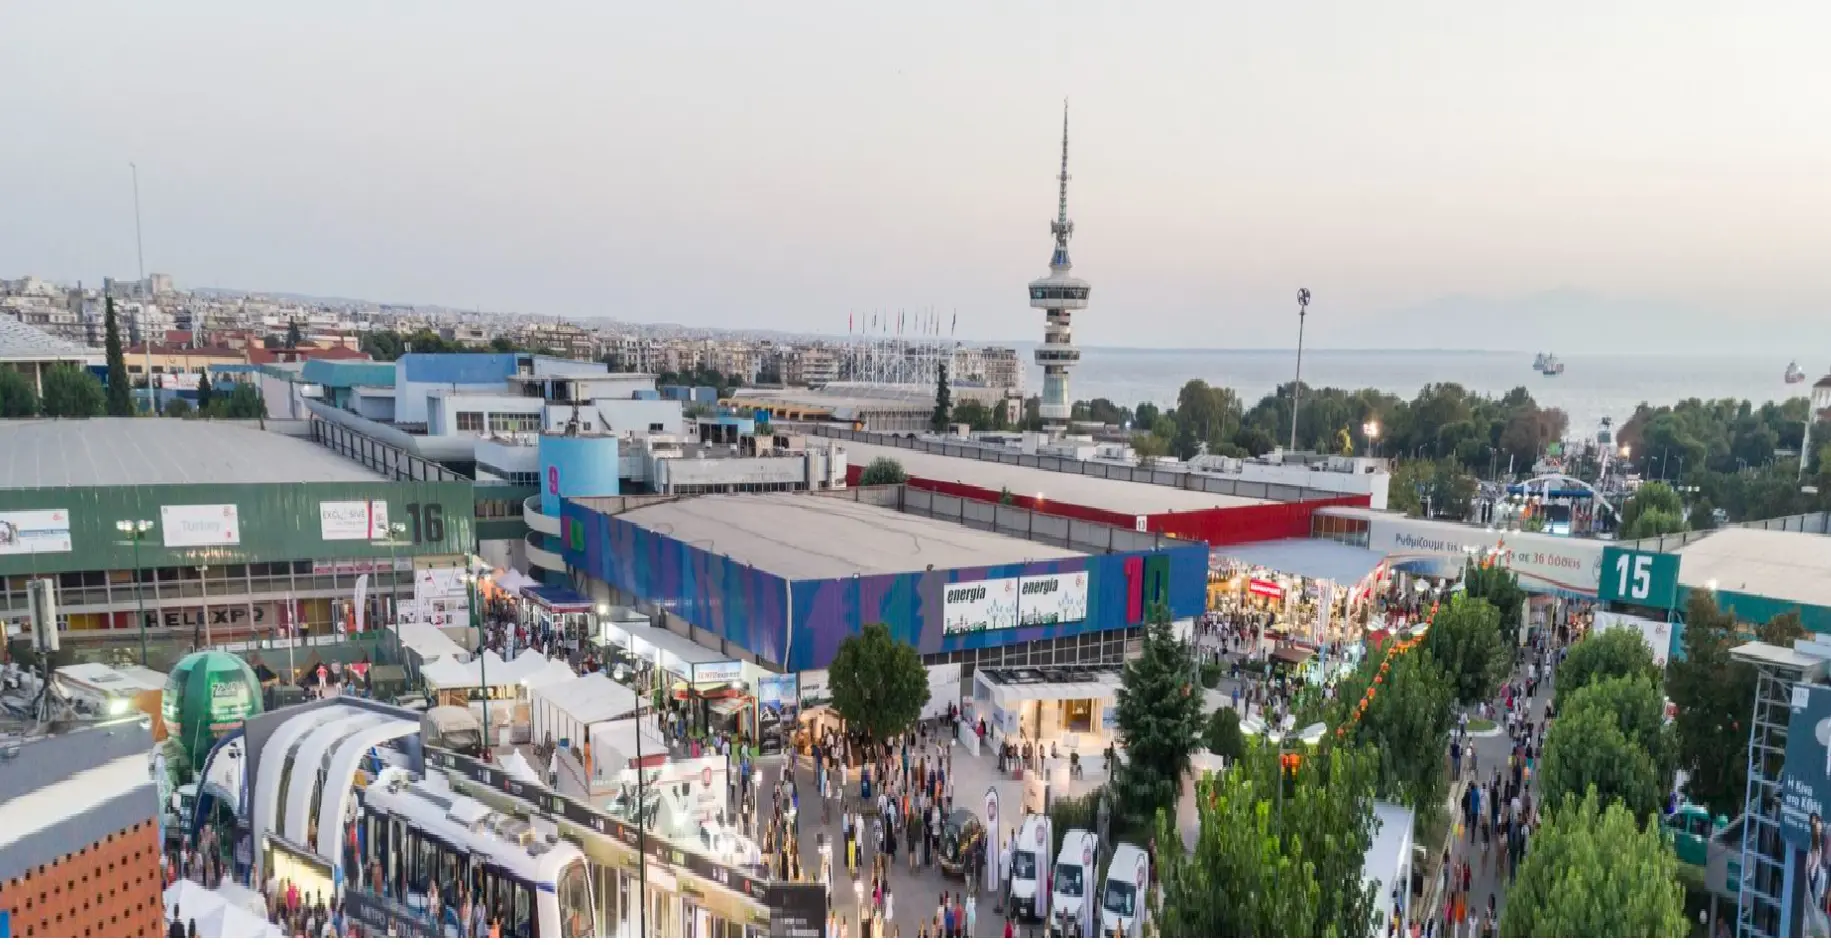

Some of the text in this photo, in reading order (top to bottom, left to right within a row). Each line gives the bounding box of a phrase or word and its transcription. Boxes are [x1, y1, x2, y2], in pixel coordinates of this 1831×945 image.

[548, 465, 559, 496] 9
[322, 508, 365, 521] EXCLSIVE
[406, 502, 444, 545] 16
[180, 520, 220, 532] Turkey
[1137, 519, 1146, 531] 13
[1532, 552, 1545, 565] 36
[1022, 578, 1058, 595] energia
[1616, 553, 1653, 600] 15
[947, 584, 986, 604] energia
[1123, 555, 1171, 626] 10
[145, 606, 265, 628] HELEXPO
